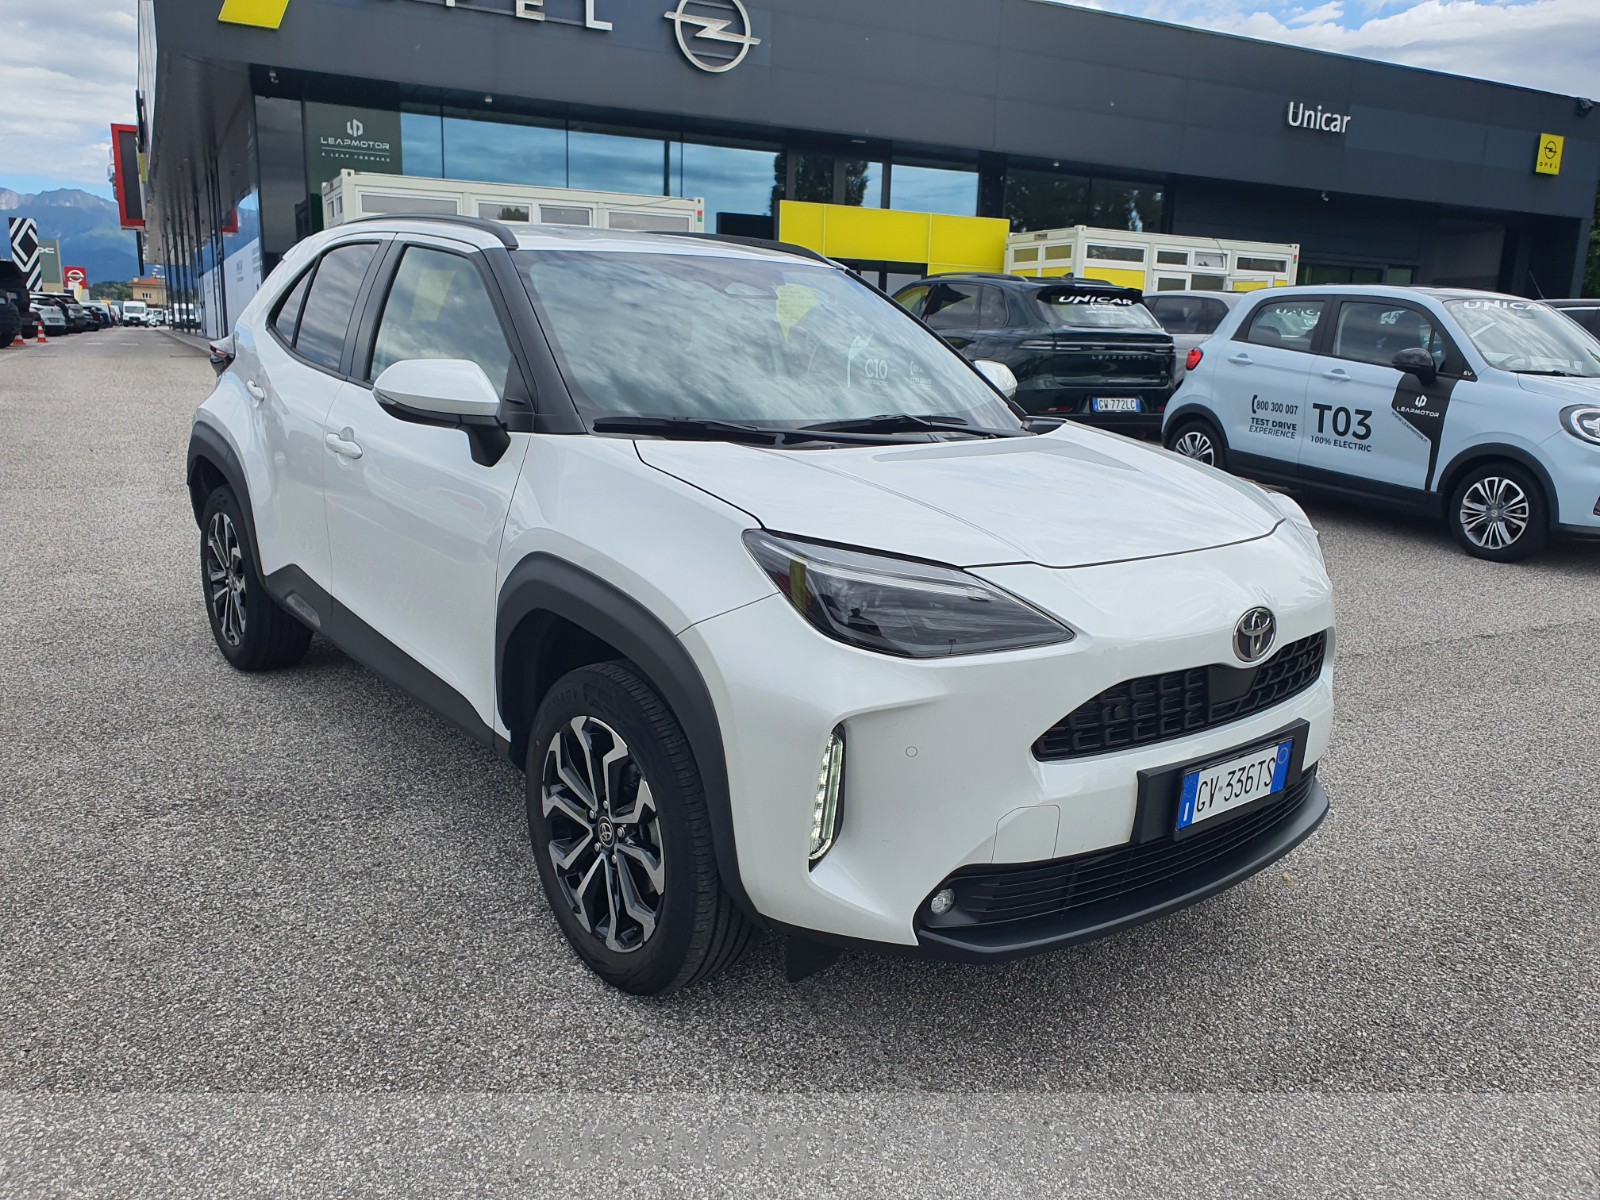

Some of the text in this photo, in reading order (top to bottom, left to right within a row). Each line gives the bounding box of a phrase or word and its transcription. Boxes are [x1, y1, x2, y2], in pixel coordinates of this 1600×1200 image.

[1288, 101, 1351, 133] Unicar
[320, 136, 390, 150] LEAPMOTOR
[1539, 161, 1557, 169] OPEL
[1058, 294, 1133, 306] UNICAR
[1256, 400, 1299, 415] 800 300 007
[1396, 406, 1440, 418] LEAPMOTOR
[1250, 416, 1297, 432] TEST DRIVE
[1312, 402, 1373, 441] T03
[1248, 425, 1296, 440] EXPERIENCE
[1310, 435, 1372, 453] 100% ELECTRIC
